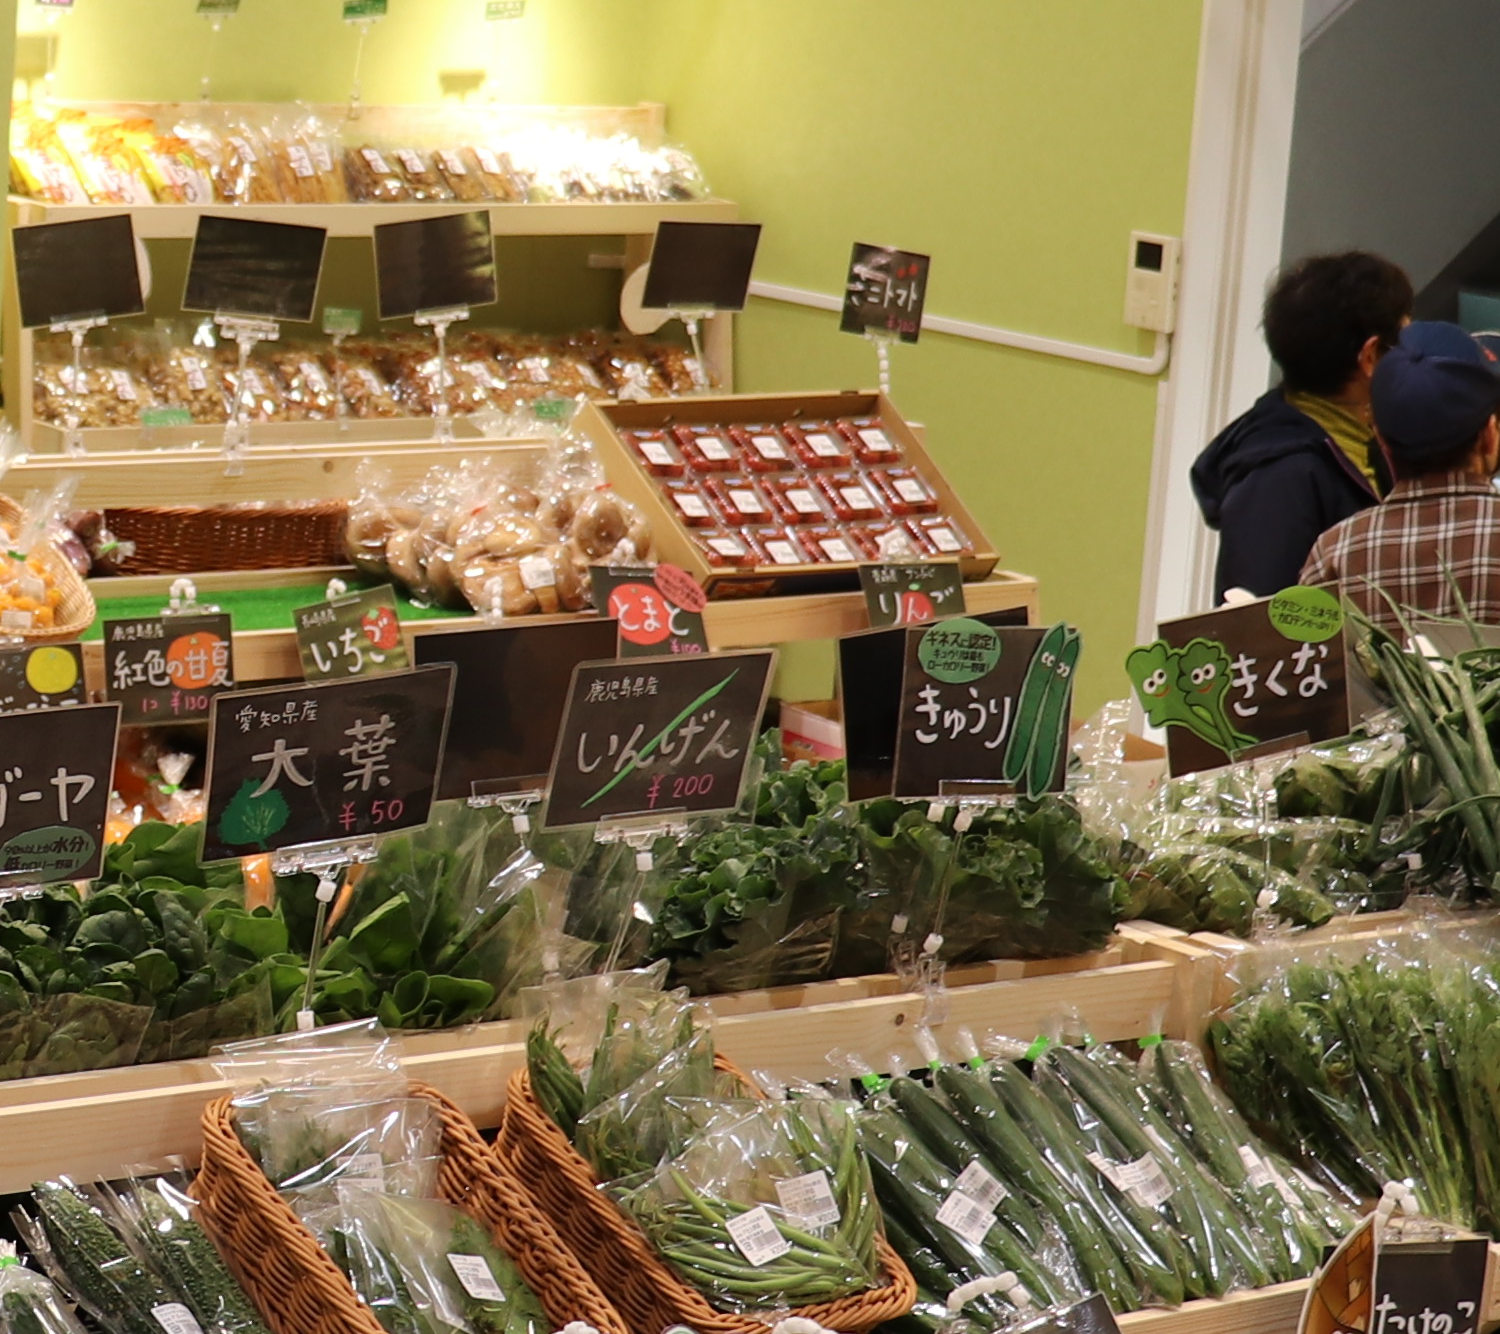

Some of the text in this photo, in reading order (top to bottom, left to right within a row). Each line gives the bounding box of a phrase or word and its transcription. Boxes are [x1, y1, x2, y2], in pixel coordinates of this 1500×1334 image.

[311, 617, 386, 673] いちご
[612, 595, 689, 636] とまと
[113, 640, 233, 690] 紅色の甘夏
[1231, 641, 1328, 715] きくな
[235, 700, 318, 733] 愛知県産
[577, 708, 738, 774] いんげん
[914, 683, 1013, 751] きゅうり
[251, 713, 397, 799] 大葉
